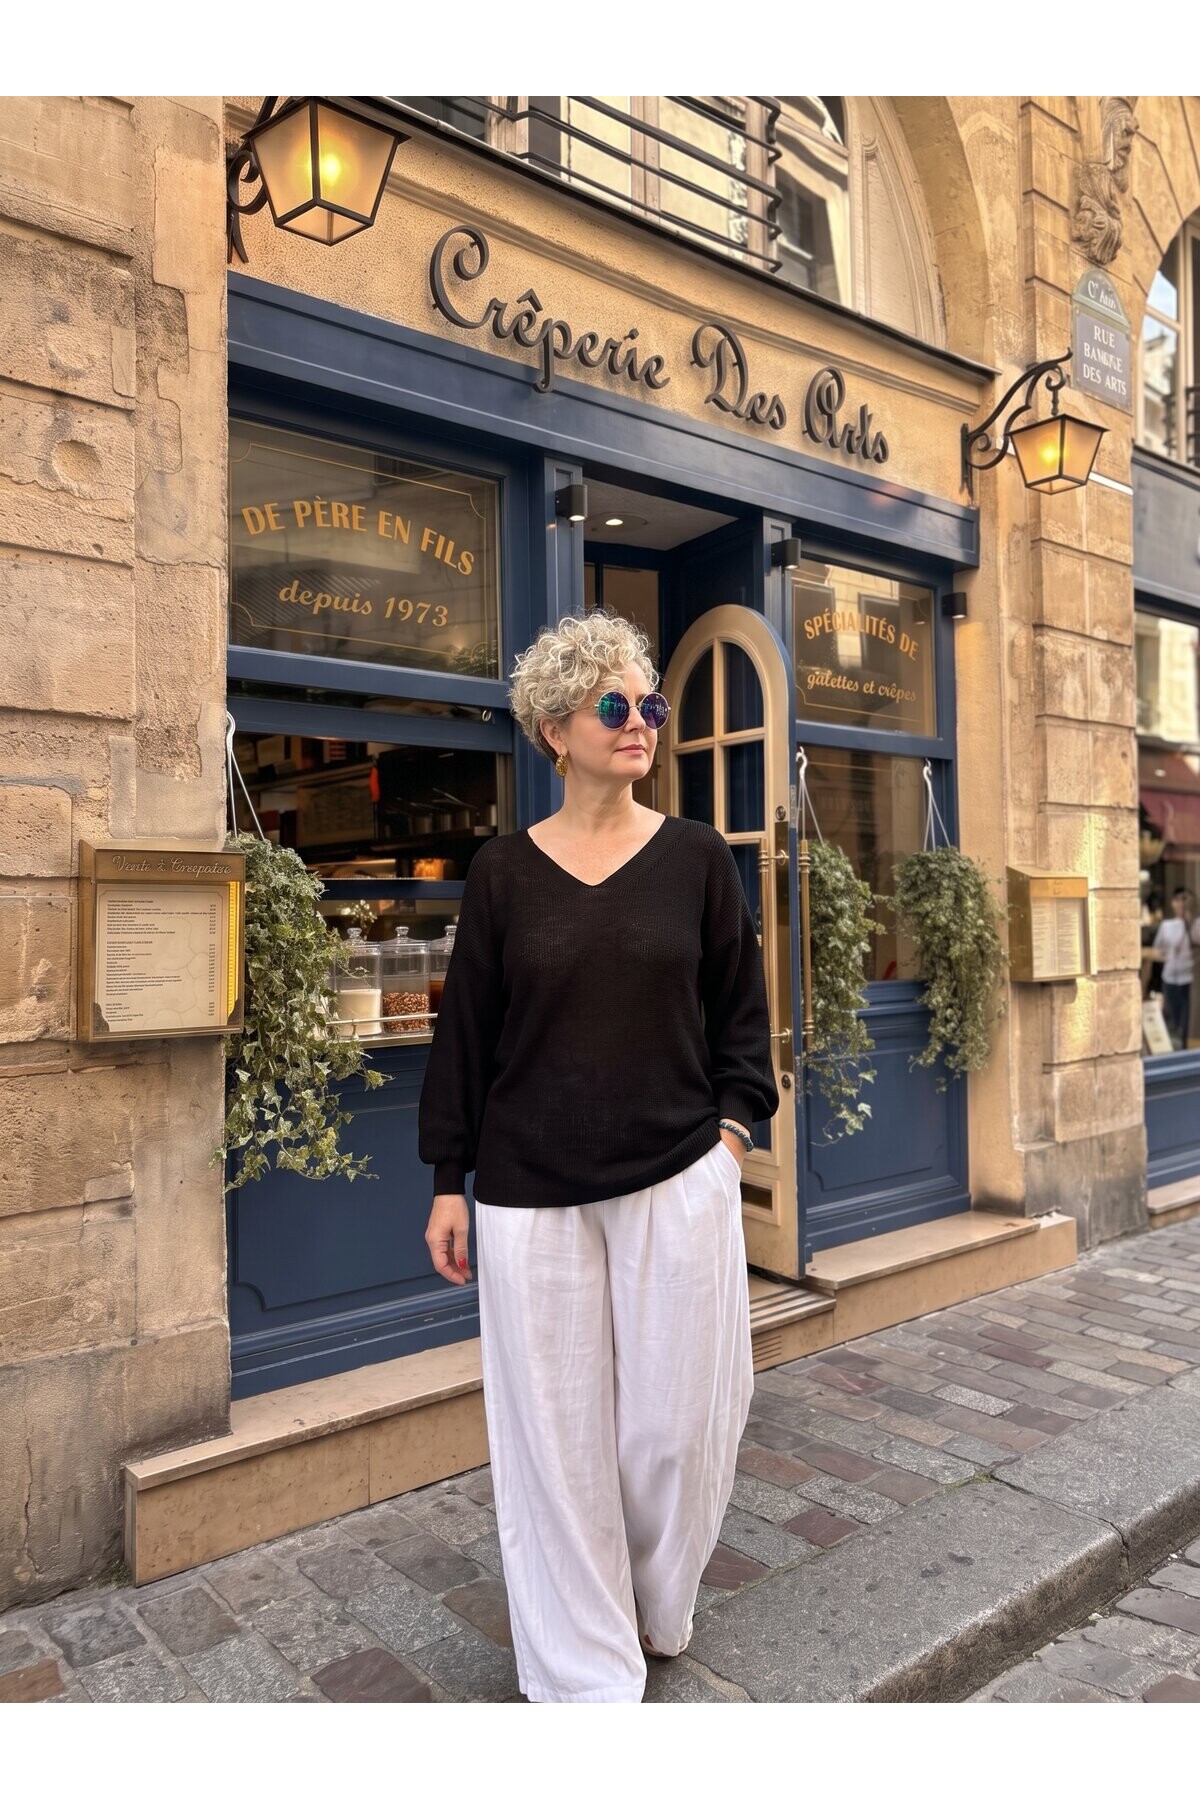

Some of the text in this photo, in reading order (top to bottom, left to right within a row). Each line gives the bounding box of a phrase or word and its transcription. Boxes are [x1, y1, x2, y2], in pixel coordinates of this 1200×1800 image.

[430, 225, 889, 464] Crêperie Des Arts
[1093, 325, 1115, 349] RUE
[1083, 363, 1127, 396] DES ARTS
[241, 495, 475, 576] DE PÈRE EN FILS
[278, 580, 449, 628] depuis 1973
[804, 608, 919, 661] SPÉCIALITÉS DE
[807, 670, 917, 703] galettes et crêpes
